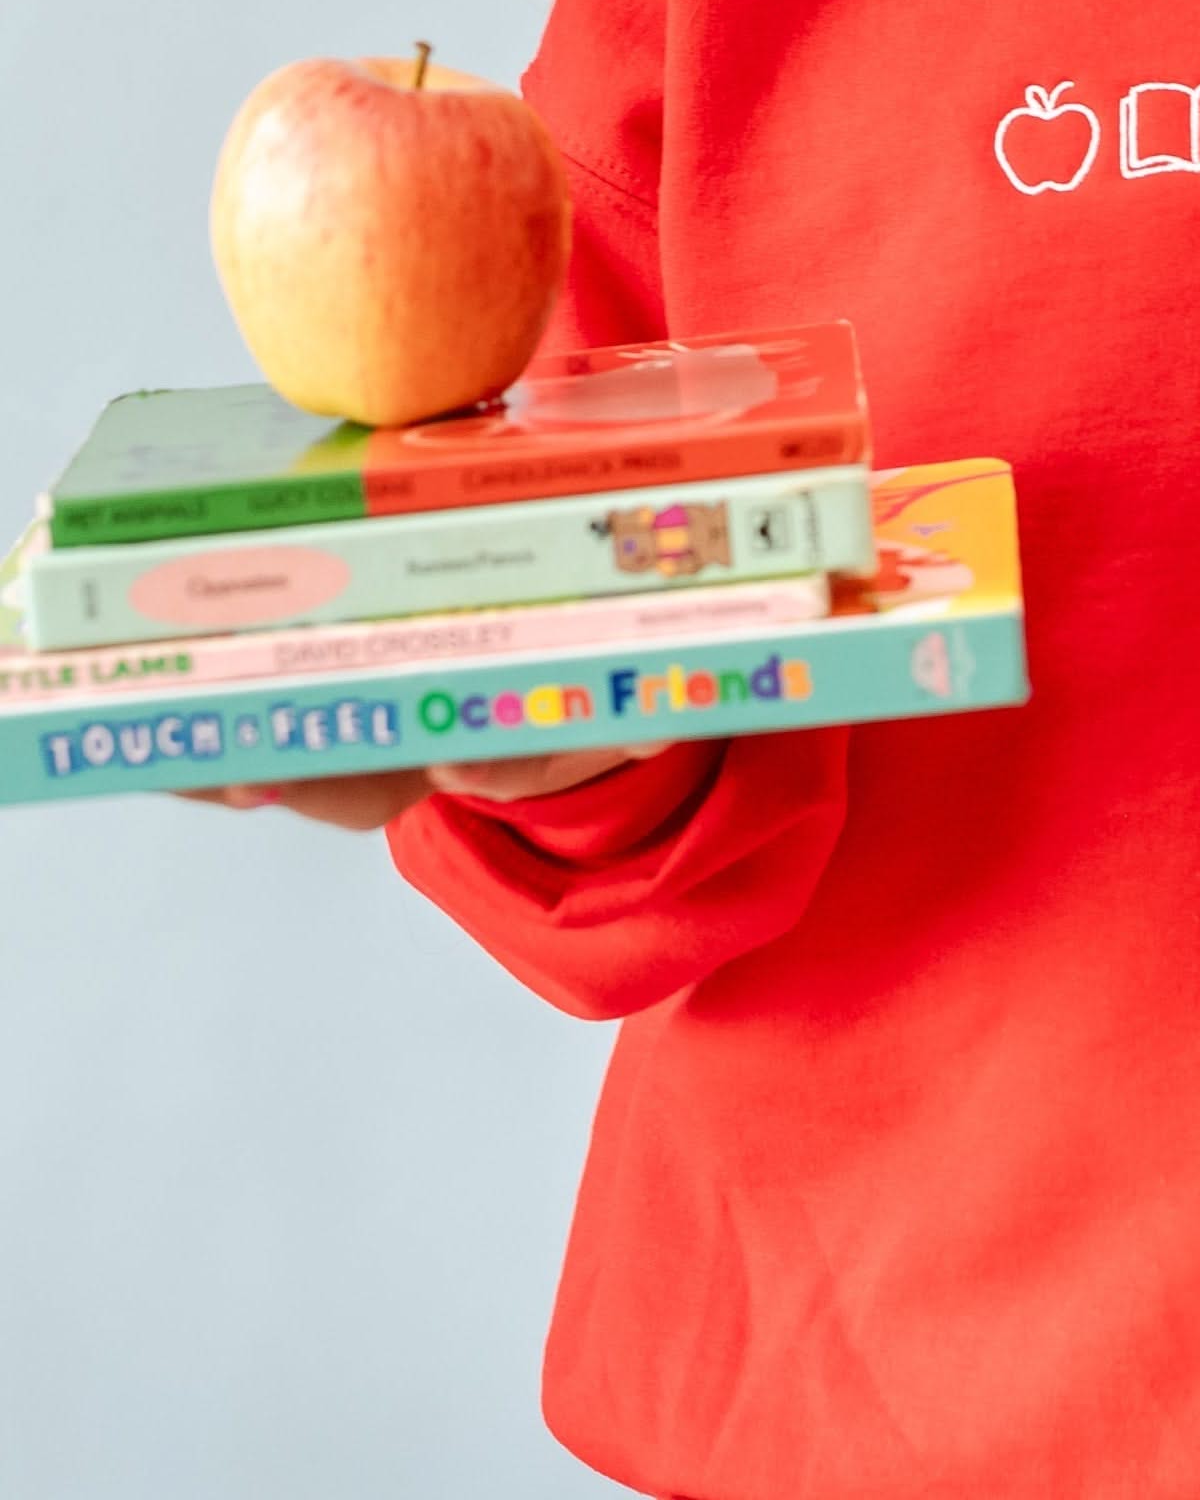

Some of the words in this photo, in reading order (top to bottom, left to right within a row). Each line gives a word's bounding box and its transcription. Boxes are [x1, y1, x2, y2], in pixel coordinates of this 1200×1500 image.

[89, 652, 192, 685] LAMB
[274, 638, 352, 669] DAVID
[368, 621, 516, 657] CROSSLEY
[418, 684, 594, 735] Ocean
[608, 653, 813, 717] Friends
[46, 712, 222, 776] TOUCH
[269, 702, 396, 750] FEEL
